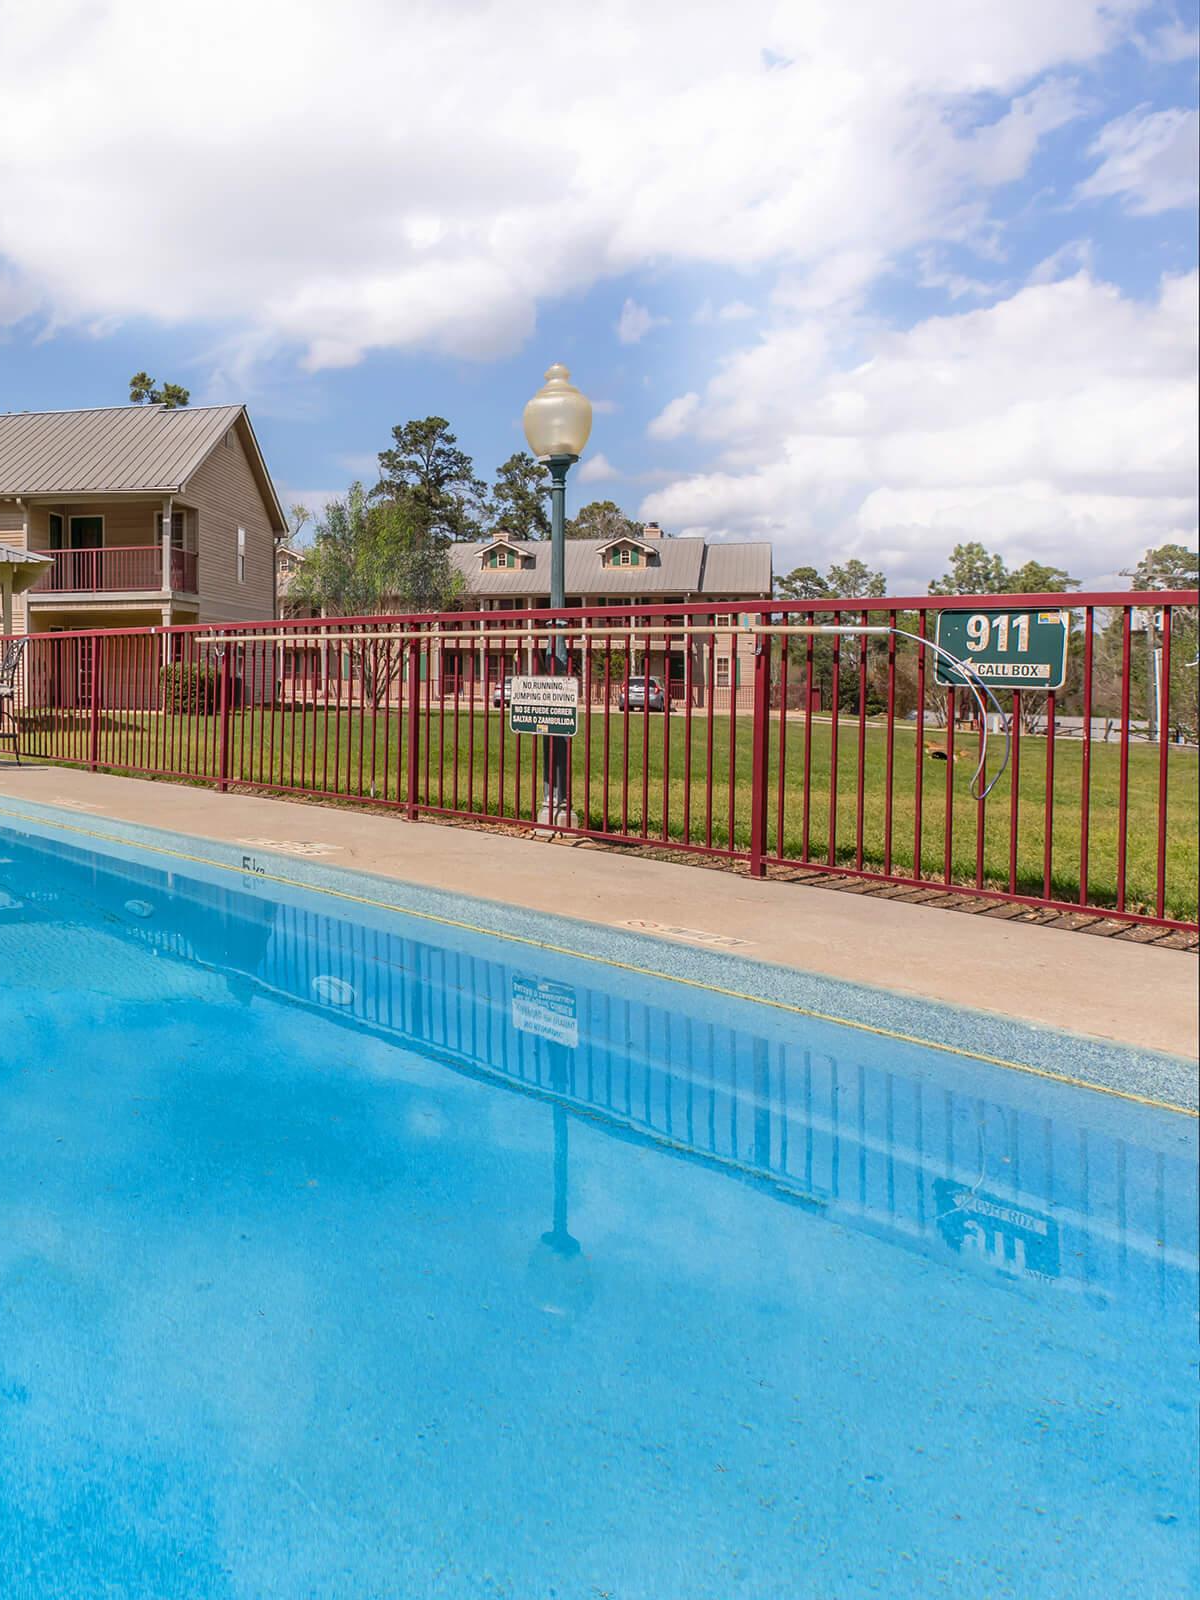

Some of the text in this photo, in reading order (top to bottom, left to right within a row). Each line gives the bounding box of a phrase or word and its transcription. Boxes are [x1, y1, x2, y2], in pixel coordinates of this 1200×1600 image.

[966, 614, 1030, 652] 911
[977, 664, 1039, 677] CALL BOX
[513, 693, 575, 702] JUMPING OR DIVING
[532, 707, 549, 715] PUEDE
[513, 715, 533, 723] SALTAR
[533, 716, 538, 724] O
